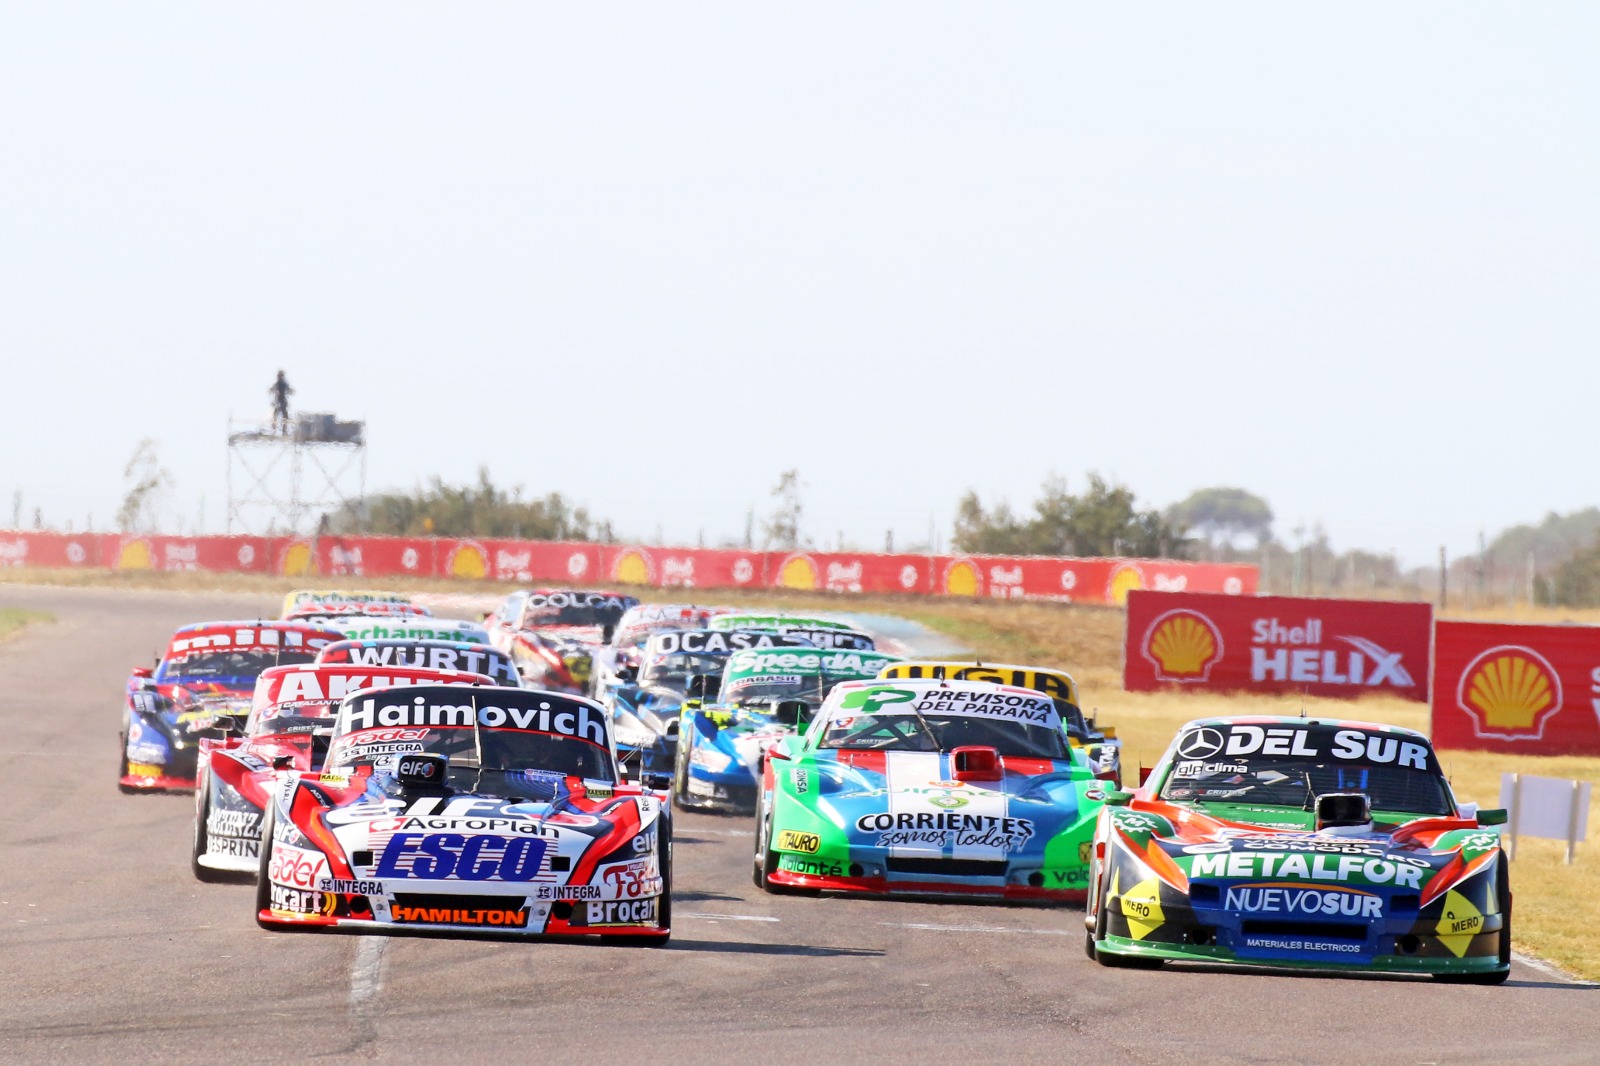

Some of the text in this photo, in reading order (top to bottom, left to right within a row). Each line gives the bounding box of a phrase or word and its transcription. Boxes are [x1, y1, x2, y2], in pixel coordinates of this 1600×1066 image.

[1252, 618, 1322, 645] Shell
[656, 632, 774, 654] OCASA
[349, 646, 516, 681] WÜRTH
[1251, 637, 1415, 687] HELIX
[918, 701, 955, 712] DEL
[923, 690, 1051, 714] PREVISORA
[341, 696, 605, 746] Haimovich
[367, 743, 422, 753] INTEGRA
[1225, 725, 1429, 770] DEL SUR
[400, 761, 423, 776] elf
[1205, 762, 1248, 773] clima
[858, 812, 1033, 837] CORRIENTES
[785, 832, 818, 851] TAURO
[876, 830, 949, 848] somos
[374, 833, 547, 882] ESCO
[1243, 843, 1431, 867] COMODORO
[1190, 851, 1424, 890] METALFOR
[334, 880, 383, 895] INTEGRA
[553, 885, 601, 899] INTEGRA
[1124, 898, 1150, 917] MERO
[1225, 888, 1383, 918] NUEVOSUR
[392, 905, 524, 925] HAMILTON
[1451, 916, 1479, 933] MERO
[1247, 938, 1361, 953] MATERIALES ELECTRICOS
